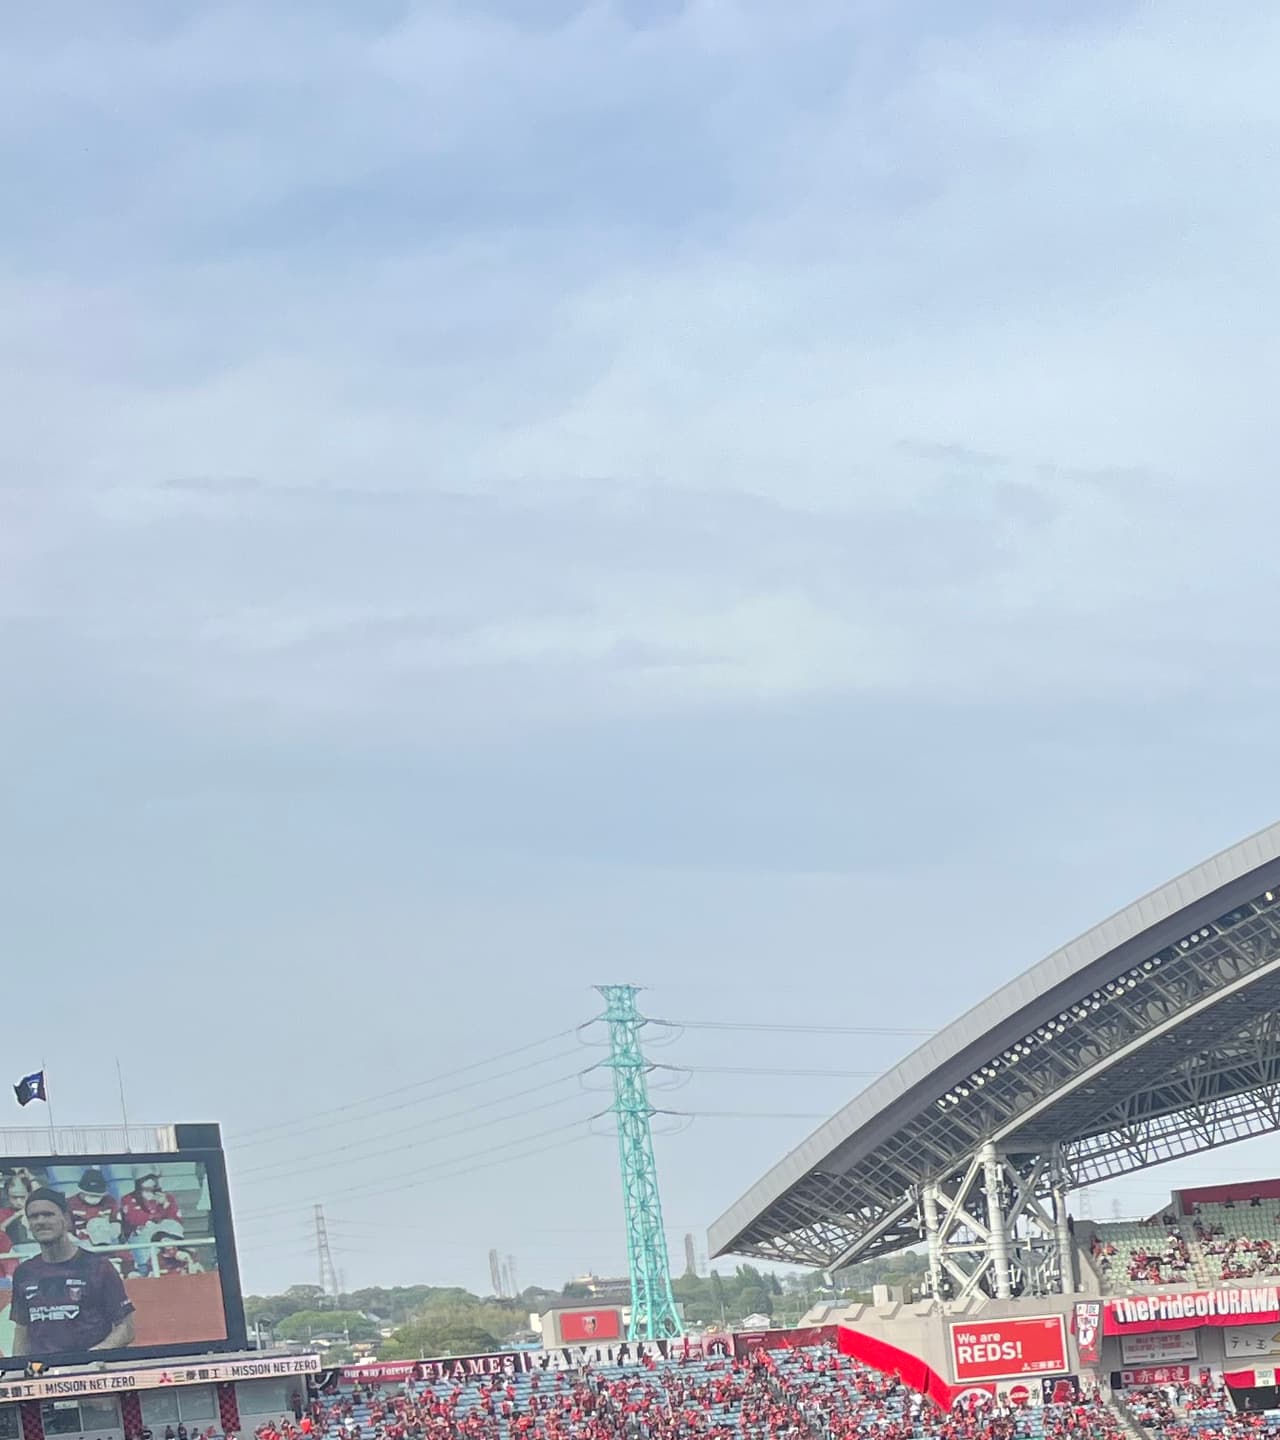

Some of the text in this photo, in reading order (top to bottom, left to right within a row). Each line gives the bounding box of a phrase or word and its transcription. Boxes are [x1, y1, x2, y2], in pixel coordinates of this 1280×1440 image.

[957, 1332, 1001, 1345] We are
[958, 1342, 1023, 1364] REDS!
[232, 1359, 318, 1377] MISSION NET ZERO
[422, 1354, 514, 1379] FLAMES
[46, 1376, 136, 1394] MISSION NET ZERO
